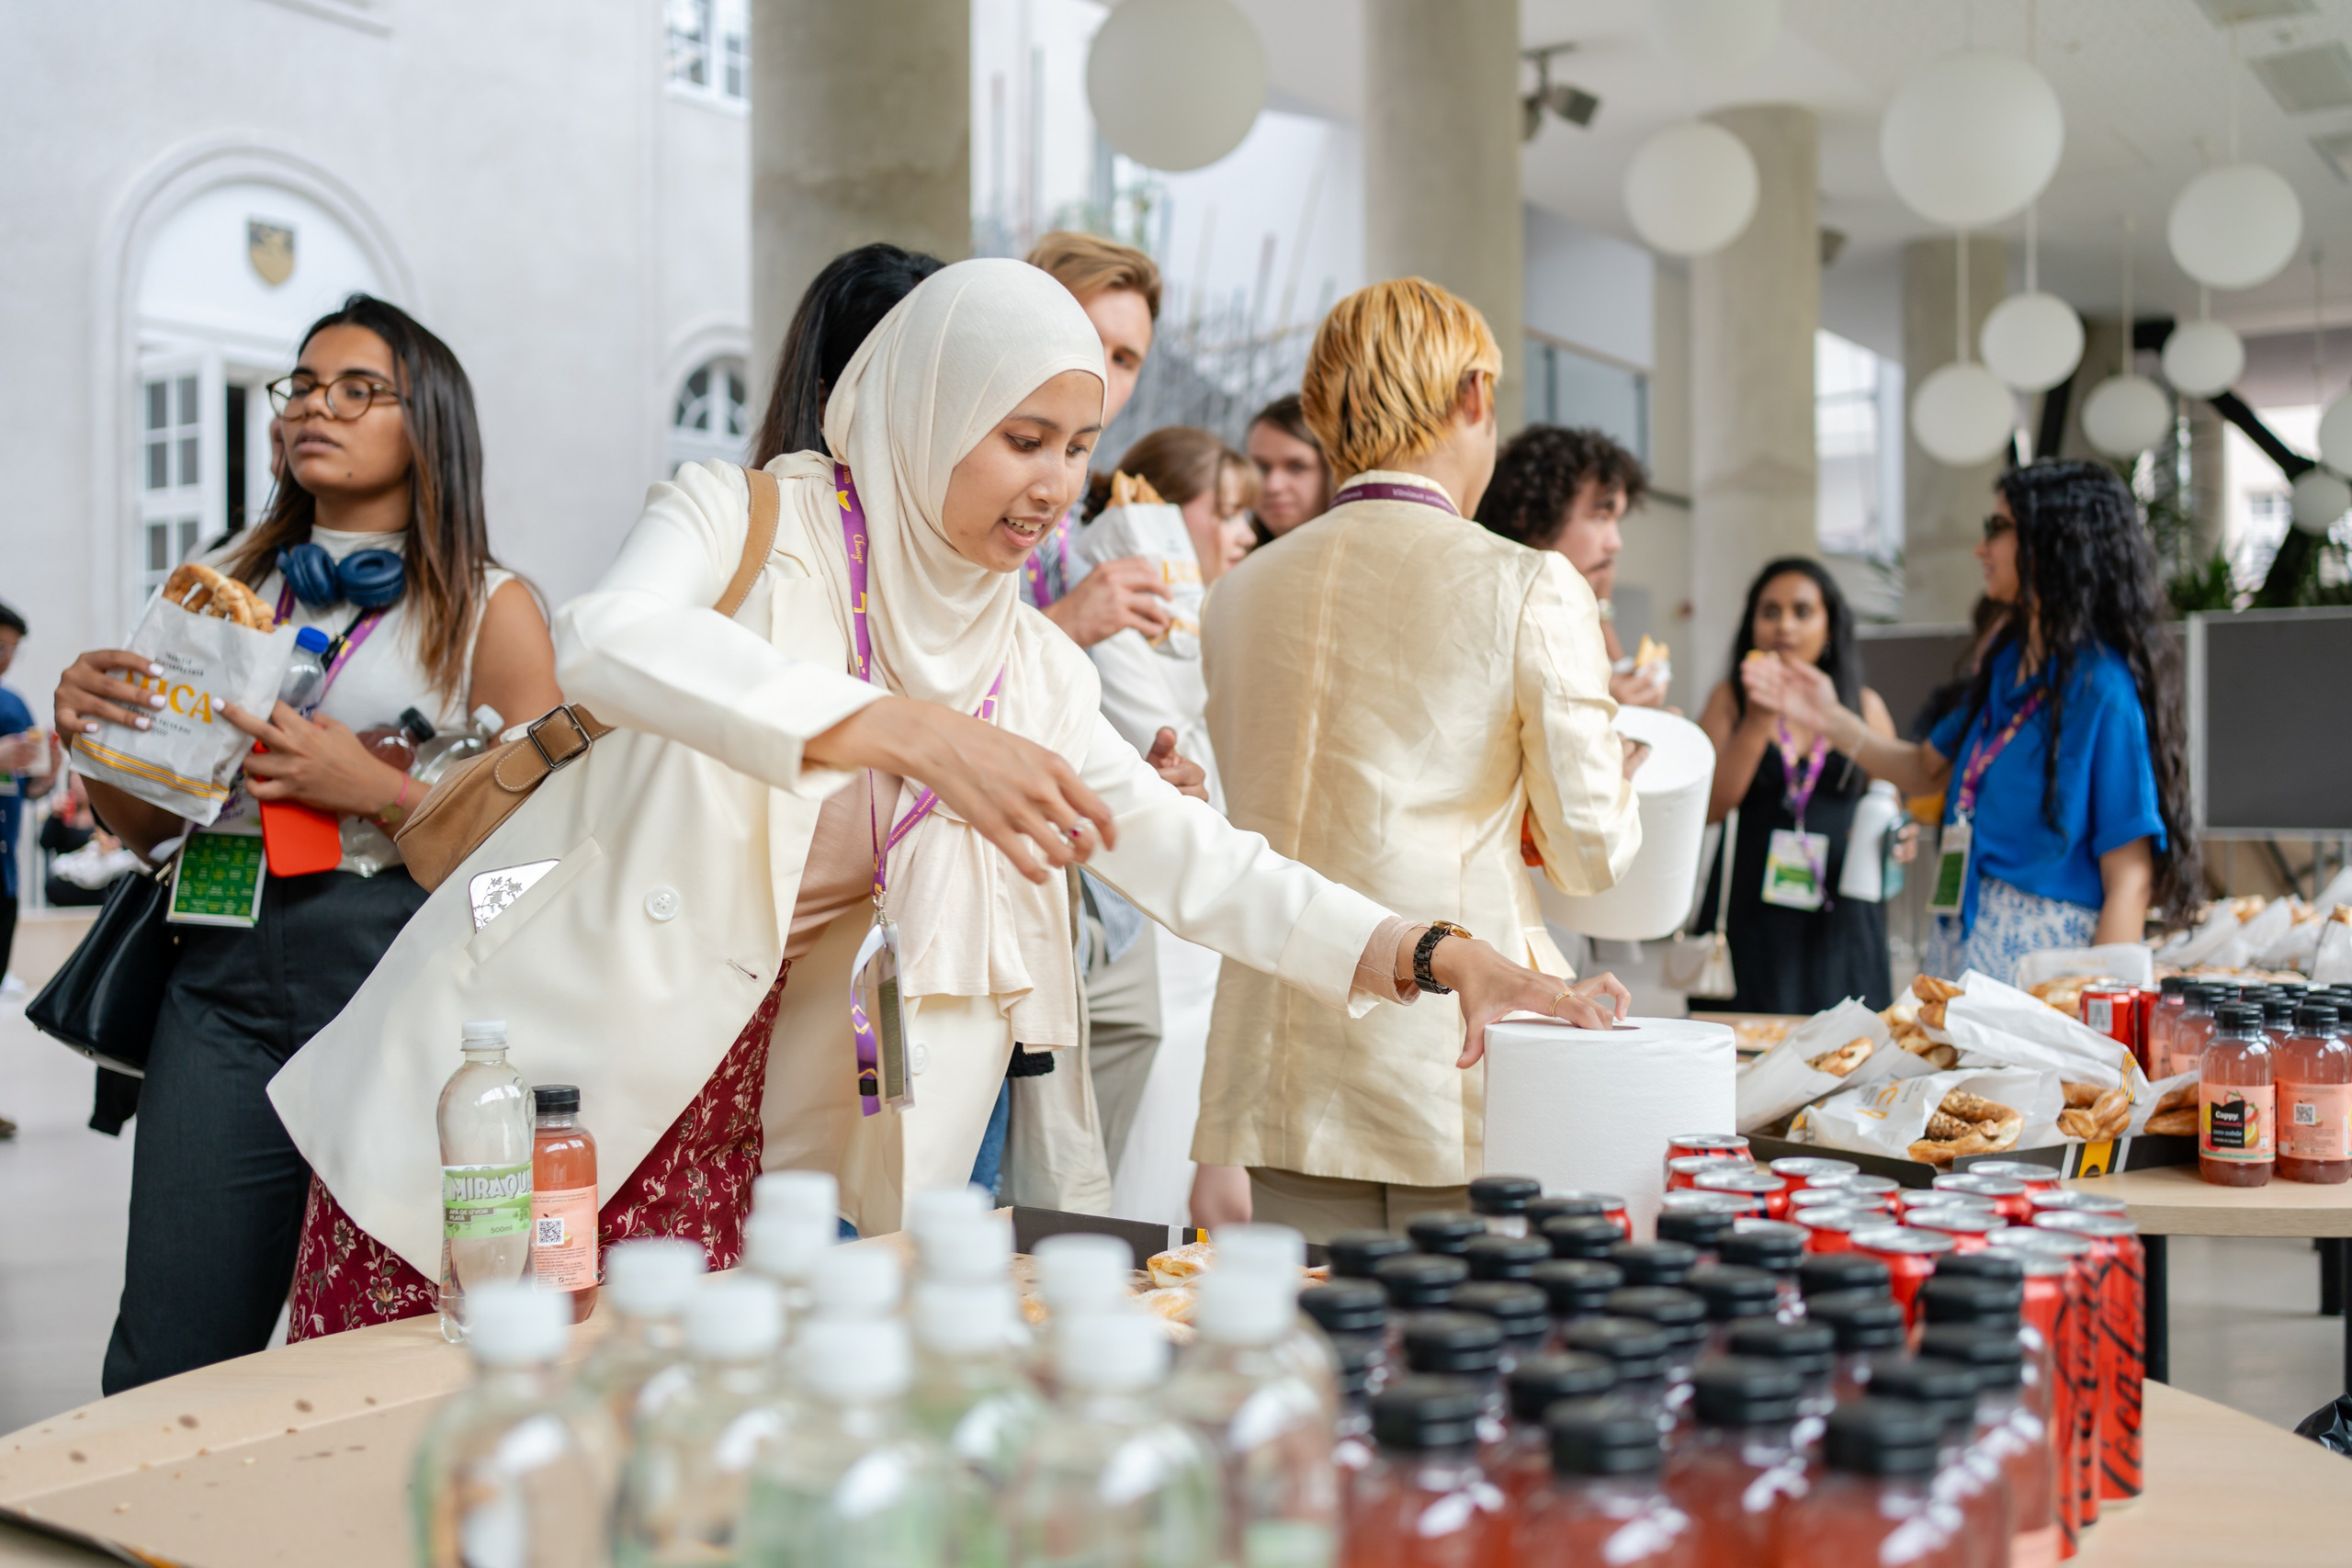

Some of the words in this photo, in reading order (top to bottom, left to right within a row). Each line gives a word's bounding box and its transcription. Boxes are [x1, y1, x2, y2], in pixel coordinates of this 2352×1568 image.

[851, 534, 866, 565] Change
[125, 668, 213, 726] CA
[2215, 1111, 2239, 1121] Cappy
[491, 1224, 513, 1234] 500ml
